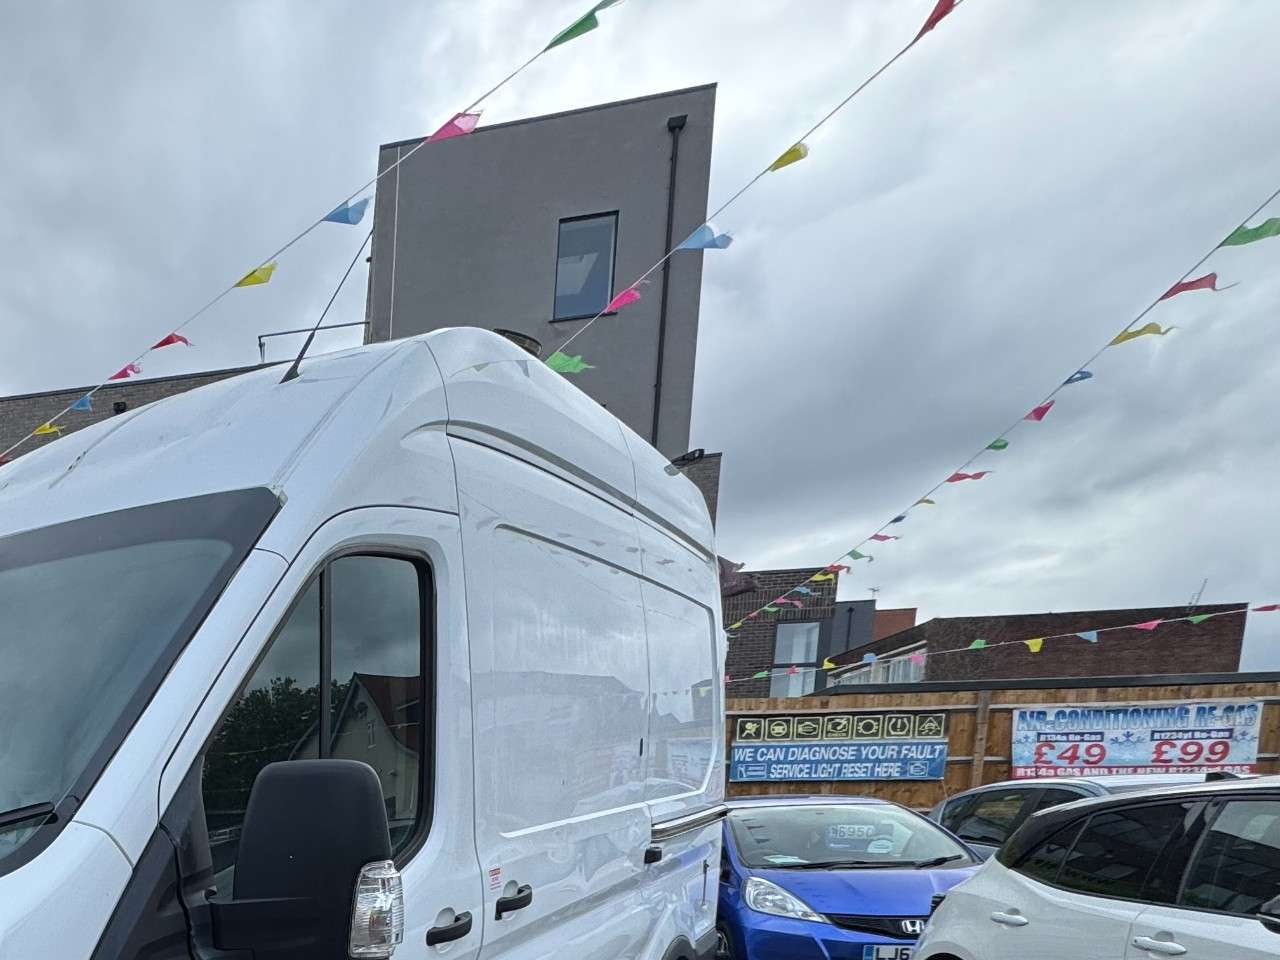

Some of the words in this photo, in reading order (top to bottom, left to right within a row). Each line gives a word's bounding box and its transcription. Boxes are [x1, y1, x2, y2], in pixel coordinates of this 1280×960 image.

[1194, 703, 1258, 728] RE-GAS
[734, 749, 754, 761] WE
[757, 748, 785, 761] CAN
[788, 746, 857, 761] DIAGNOSE
[861, 745, 898, 759] YOUR
[901, 745, 942, 759] FAULT
[1034, 742, 1106, 765] £49
[1151, 741, 1230, 763] £99
[770, 764, 811, 778] SERVICE
[812, 764, 841, 777] LIGHT
[842, 763, 872, 777] RESET
[876, 762, 902, 776] HERE
[1057, 767, 1082, 776] GAS
[1083, 766, 1109, 775] AND
[1110, 766, 1136, 775] THE
[876, 947, 911, 960] LJ6
